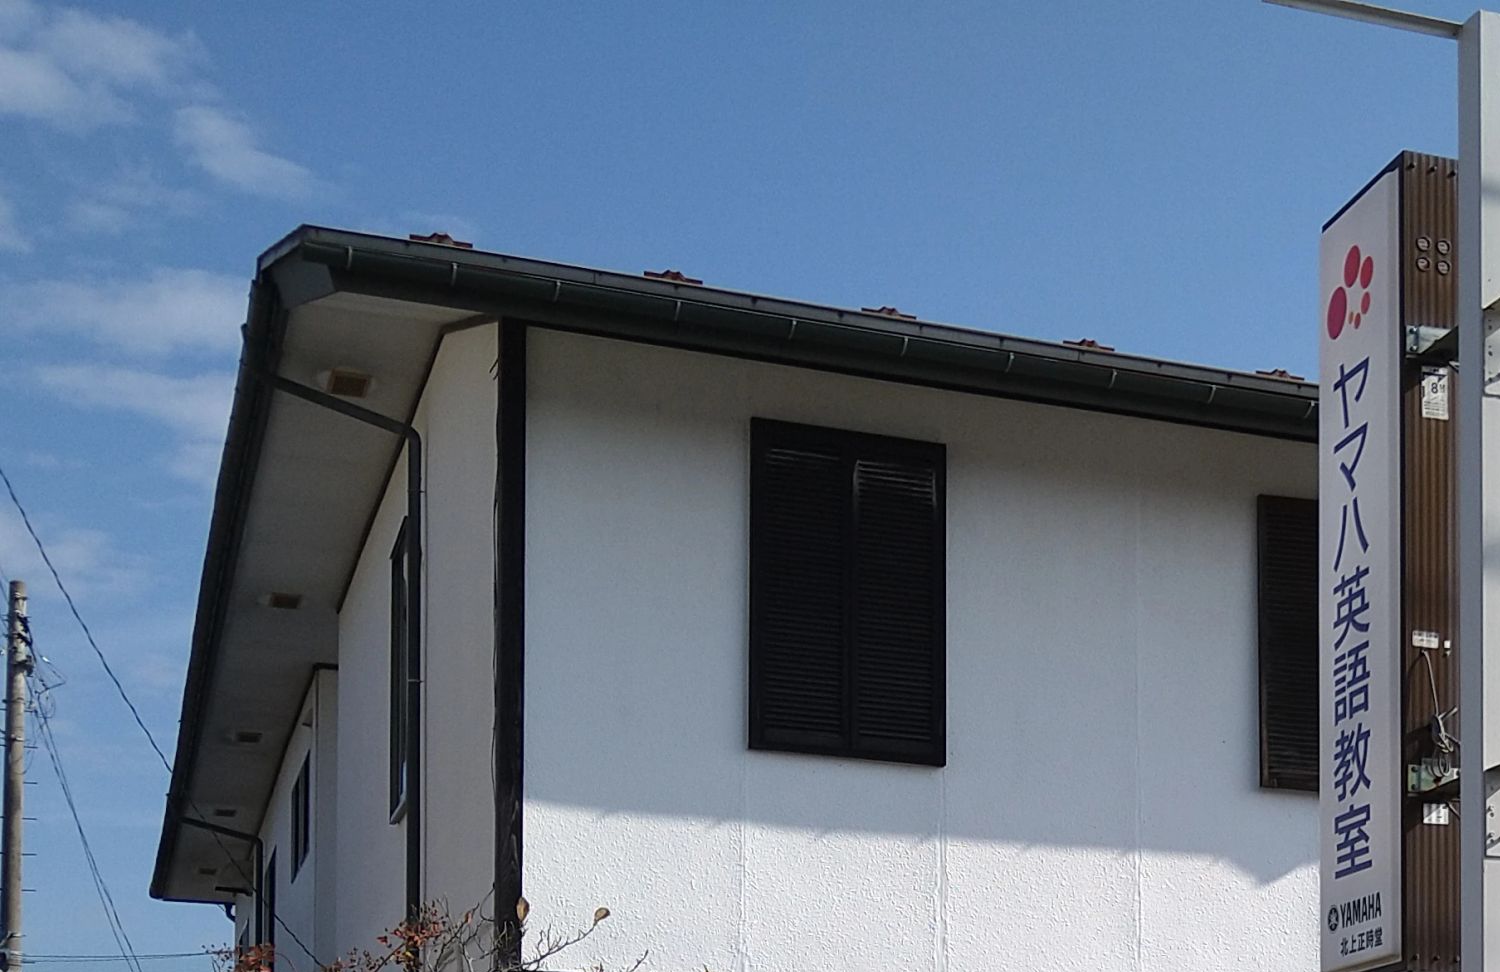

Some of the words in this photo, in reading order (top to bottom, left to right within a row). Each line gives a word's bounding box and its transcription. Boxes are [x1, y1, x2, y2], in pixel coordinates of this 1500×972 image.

[1332, 356, 1373, 880] ヤマハ英語教室
[1340, 891, 1382, 928] YAMAHA
[1340, 926, 1383, 957] 北上正時堂
